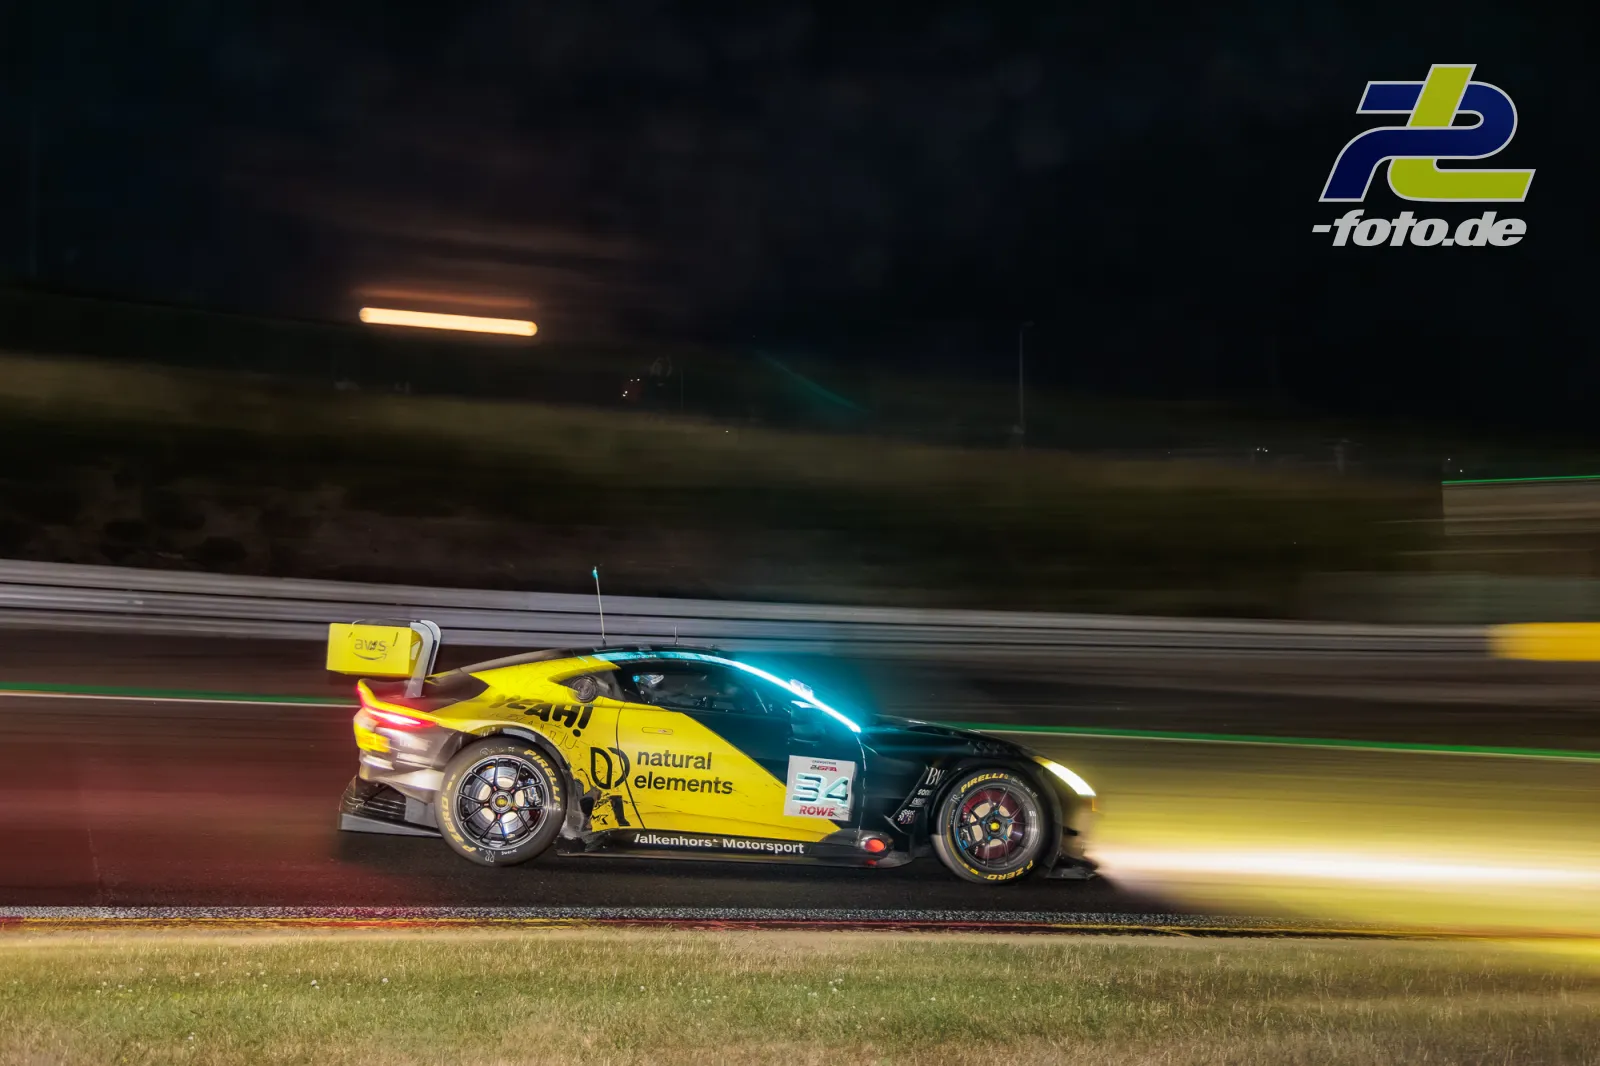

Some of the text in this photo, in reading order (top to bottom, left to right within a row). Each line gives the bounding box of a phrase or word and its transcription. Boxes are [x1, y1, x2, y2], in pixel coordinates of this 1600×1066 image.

[354, 638, 387, 652] aws
[637, 750, 713, 770] natural
[524, 749, 561, 802] PIRELLI
[634, 771, 734, 795] elements
[960, 773, 1004, 793] PIRELLI
[792, 773, 850, 809] 34
[441, 796, 465, 843] ZERO
[799, 805, 836, 817] ROWE
[723, 838, 804, 854] Motorsport
[986, 867, 1024, 880] ZERO
